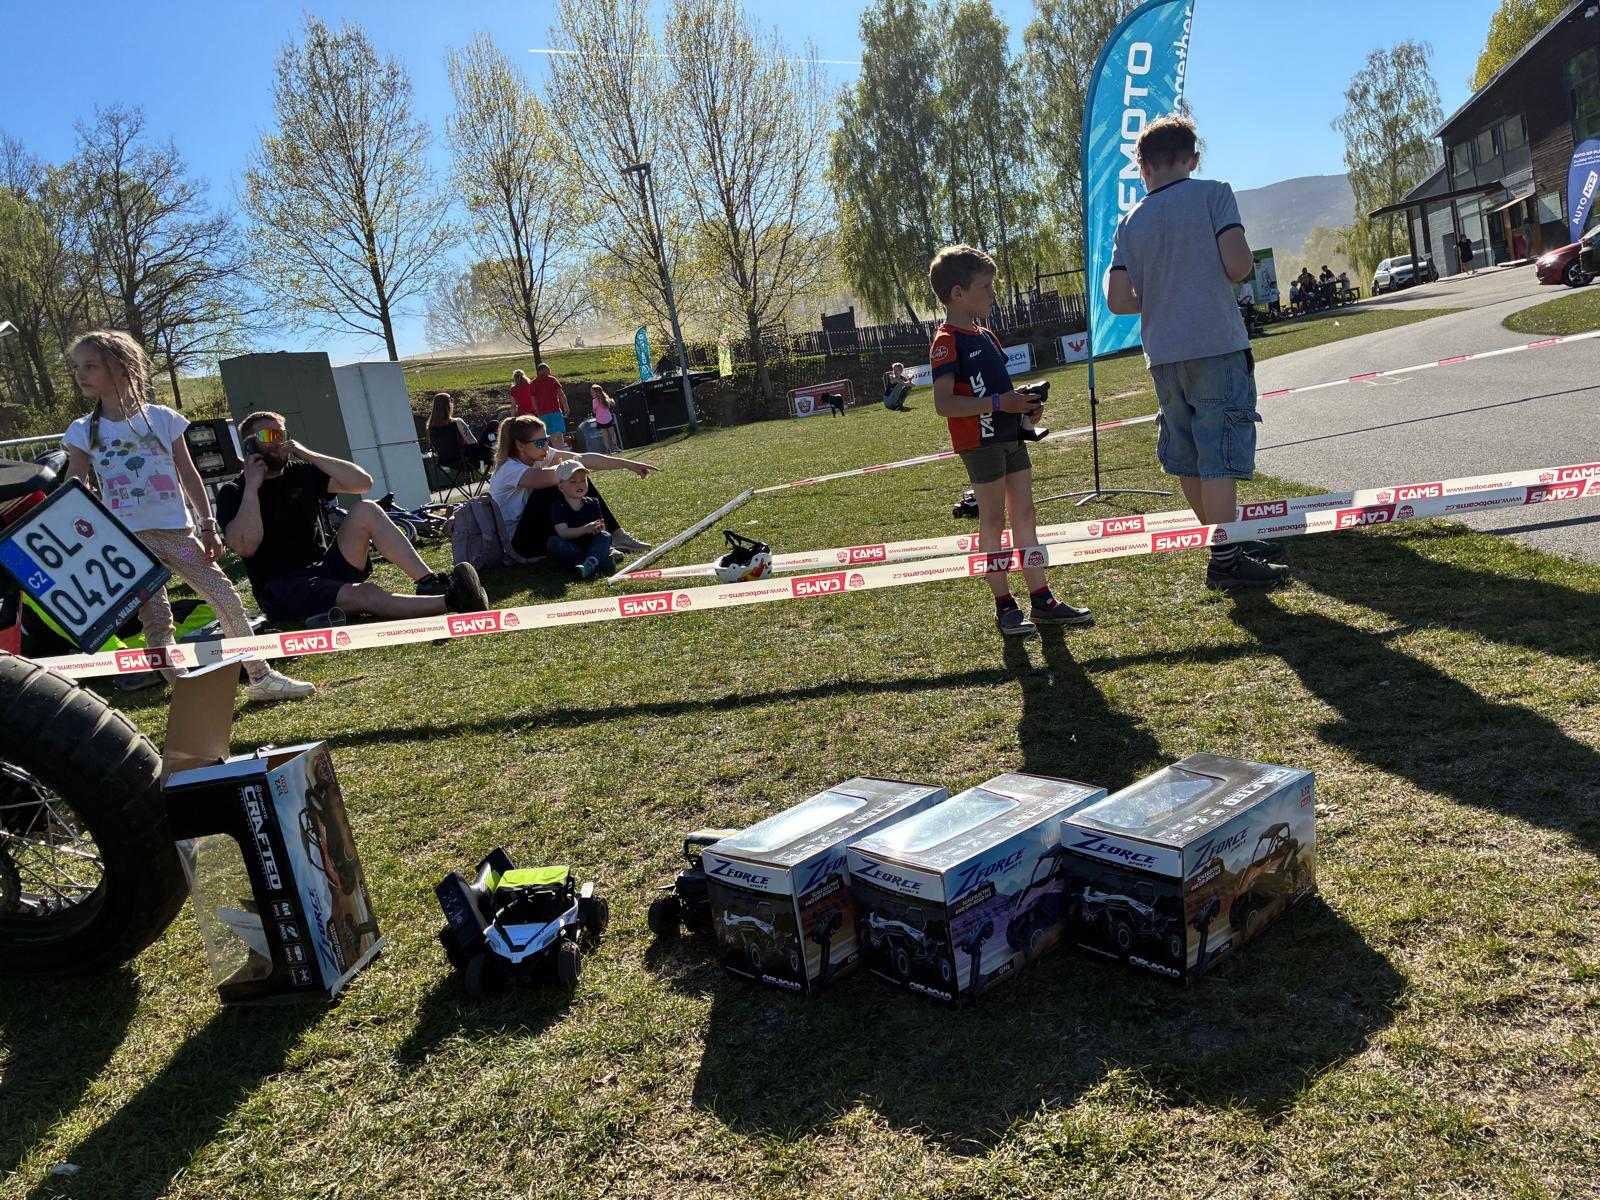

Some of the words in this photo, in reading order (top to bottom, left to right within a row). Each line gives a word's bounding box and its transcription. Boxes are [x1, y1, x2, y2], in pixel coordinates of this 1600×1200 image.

[1117, 42, 1152, 224] FMOTO
[1444, 495, 1522, 511] www.motocams.cz
[1530, 487, 1579, 503] CAMS
[853, 547, 883, 560] CAMS
[888, 544, 938, 555] www.motocams.cz
[1106, 519, 1141, 533] CAMS
[1147, 516, 1198, 527] www.motocams.
[1246, 503, 1285, 517] CAMS
[1398, 485, 1440, 500] CAMS
[1445, 480, 1513, 493] www.motocams.cz
[1256, 519, 1333, 534] www.motocams.cz
[1341, 511, 1389, 528] CAMS
[26, 523, 83, 569] 6L
[1073, 542, 1149, 557] www.motocams.cz
[1155, 532, 1202, 550] CAMS
[892, 565, 965, 579] www.motocams.cz
[973, 556, 1020, 574] CAMS
[27, 571, 49, 590] CZ
[50, 544, 136, 626] 0426
[796, 578, 841, 595] CAMS
[718, 587, 789, 600] www.motocams.cz
[546, 606, 617, 619] www.motocams.cz
[623, 596, 668, 614] CAMS
[376, 625, 446, 638] www.motocams.cz
[451, 616, 496, 633] CAMS
[284, 636, 328, 652] CAMS
[119, 653, 162, 669] CAMS
[244, 785, 283, 890] CRAFTED
[1071, 832, 1159, 864] ZFORCE
[710, 858, 771, 885] ZFORCE
[856, 858, 923, 889] ZFORCE
[1129, 955, 1180, 977] OFF-ROAD
